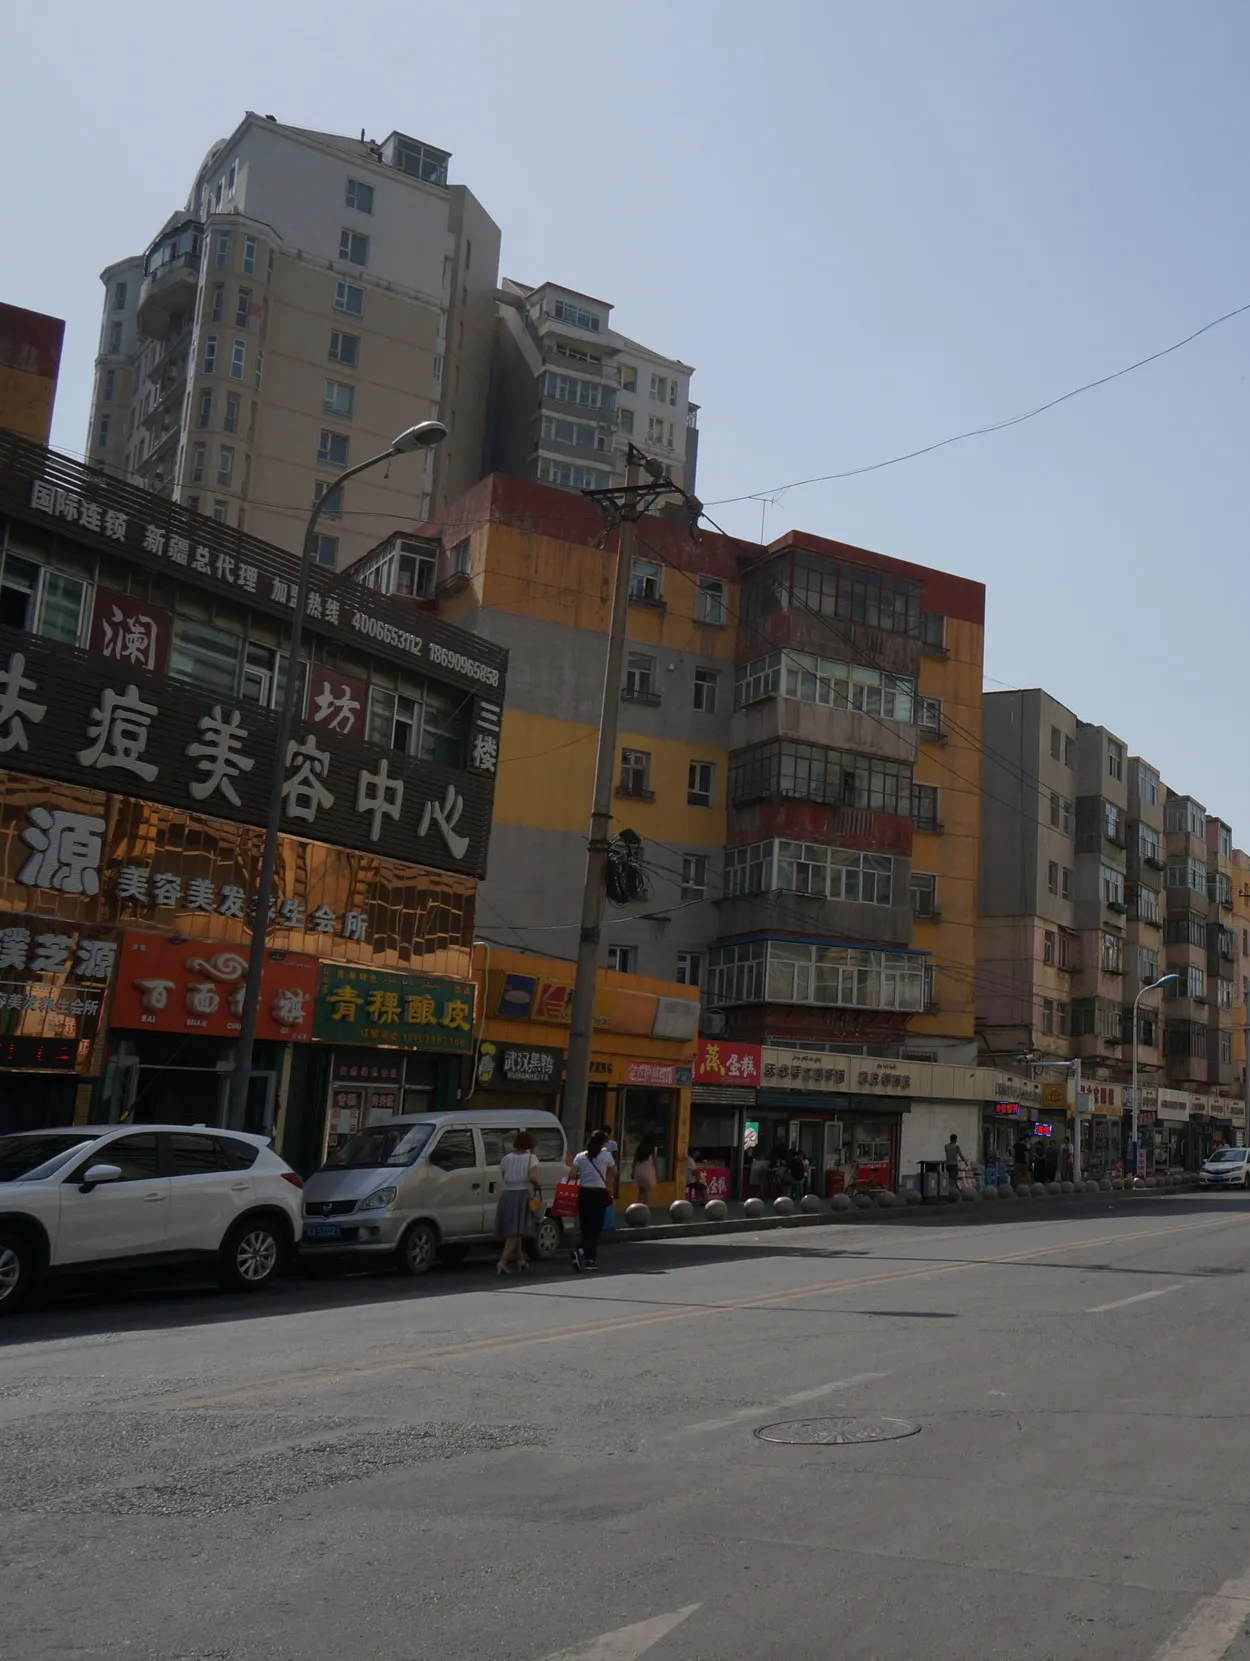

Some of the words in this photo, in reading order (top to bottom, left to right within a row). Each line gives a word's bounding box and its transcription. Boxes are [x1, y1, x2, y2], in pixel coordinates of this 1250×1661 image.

[31, 479, 128, 543] 国际连锁
[143, 522, 260, 593] 新疆总代理
[352, 611, 423, 657] 4006653112
[428, 643, 500, 688] 18690965858
[102, 603, 158, 671] 澜
[314, 682, 361, 735] 坊
[473, 701, 501, 773] 三楼
[17, 806, 106, 896] 源
[327, 985, 471, 1032] 青稞酿皮
[504, 1050, 555, 1075] 武汉黑鸭
[700, 1043, 757, 1078] 蒸蛋糕
